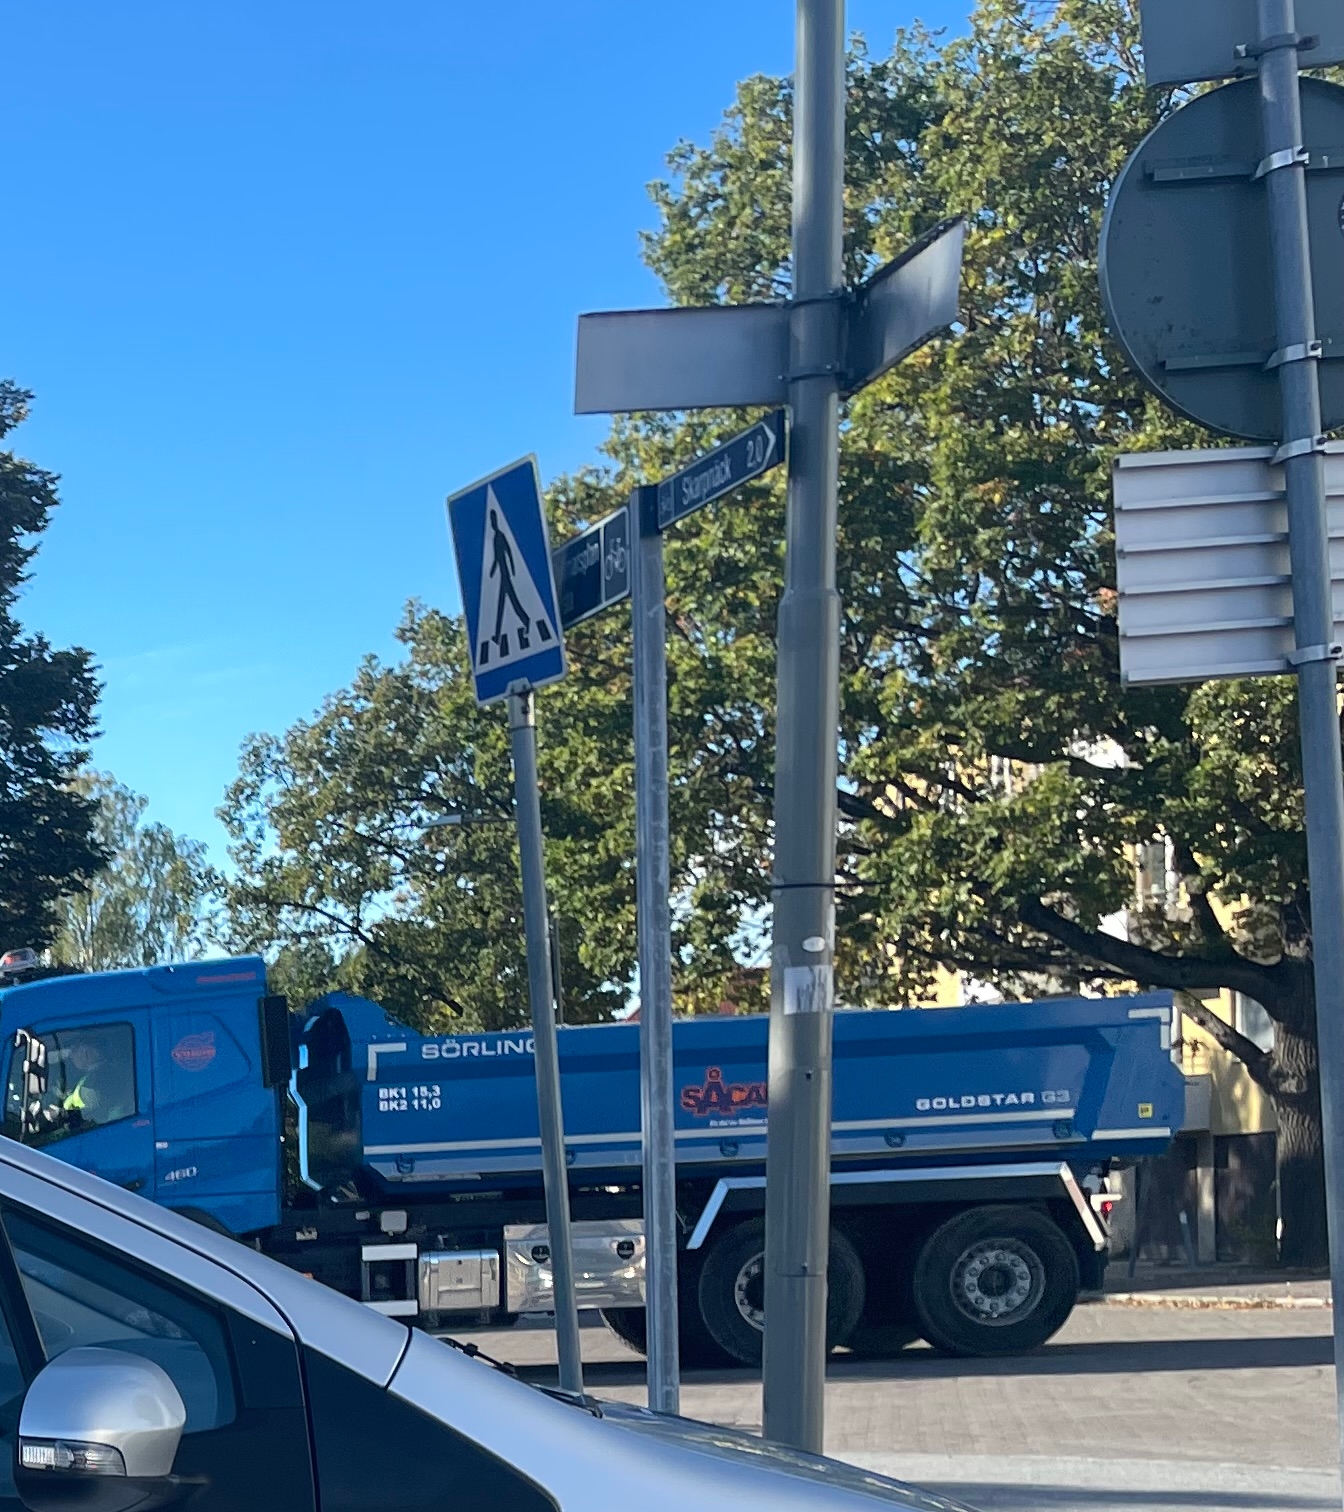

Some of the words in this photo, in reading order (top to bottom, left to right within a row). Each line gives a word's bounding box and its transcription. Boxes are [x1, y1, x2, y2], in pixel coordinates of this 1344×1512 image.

[378, 1086, 407, 1099] BK1
[378, 1099, 408, 1112] BK2
[411, 1097, 442, 1111] 11,0
[915, 1092, 1035, 1111] GOLDSTAR
